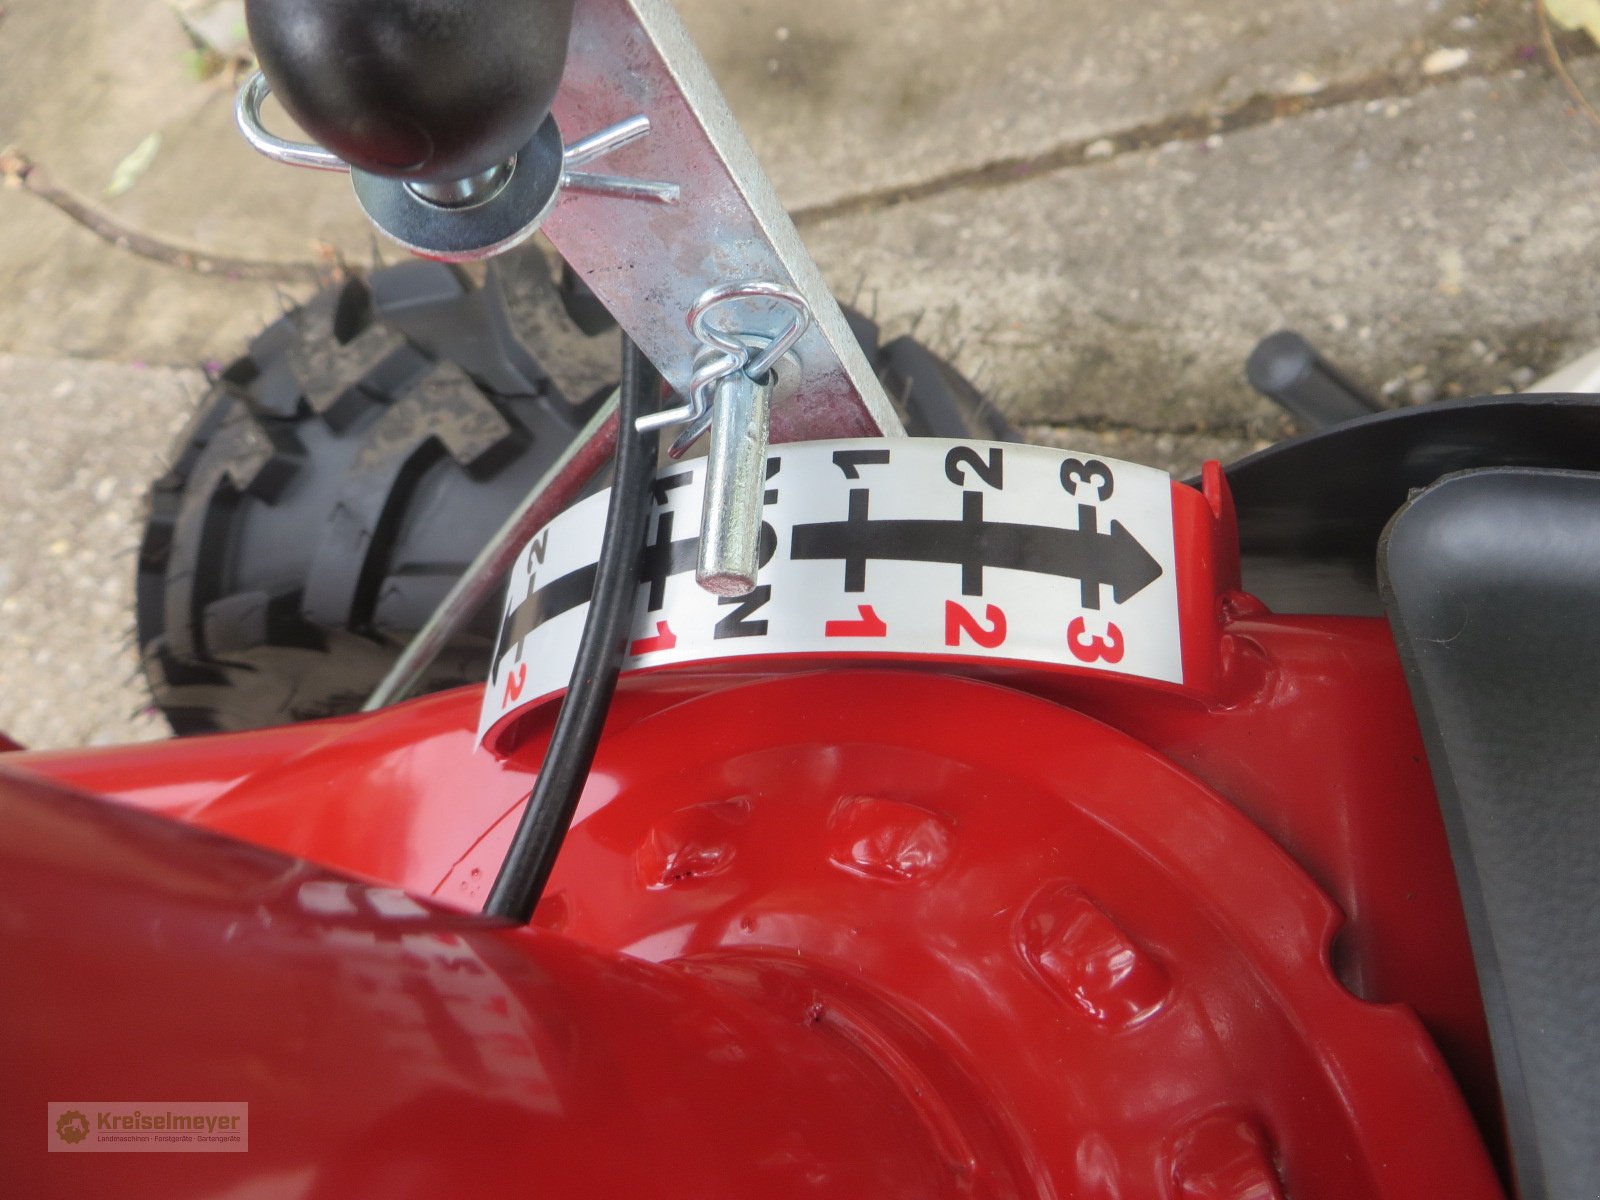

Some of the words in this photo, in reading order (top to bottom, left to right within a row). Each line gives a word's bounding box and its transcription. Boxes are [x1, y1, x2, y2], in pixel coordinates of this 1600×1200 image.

[832, 449, 890, 479] 1
[945, 446, 1003, 490] 2
[1060, 457, 1114, 502] 3
[649, 470, 693, 506] 1
[527, 528, 549, 574] 2
[629, 619, 676, 656] 1
[825, 604, 887, 637] 1
[945, 599, 1007, 649] 2
[1066, 615, 1125, 664] 3
[502, 662, 527, 709] 2
